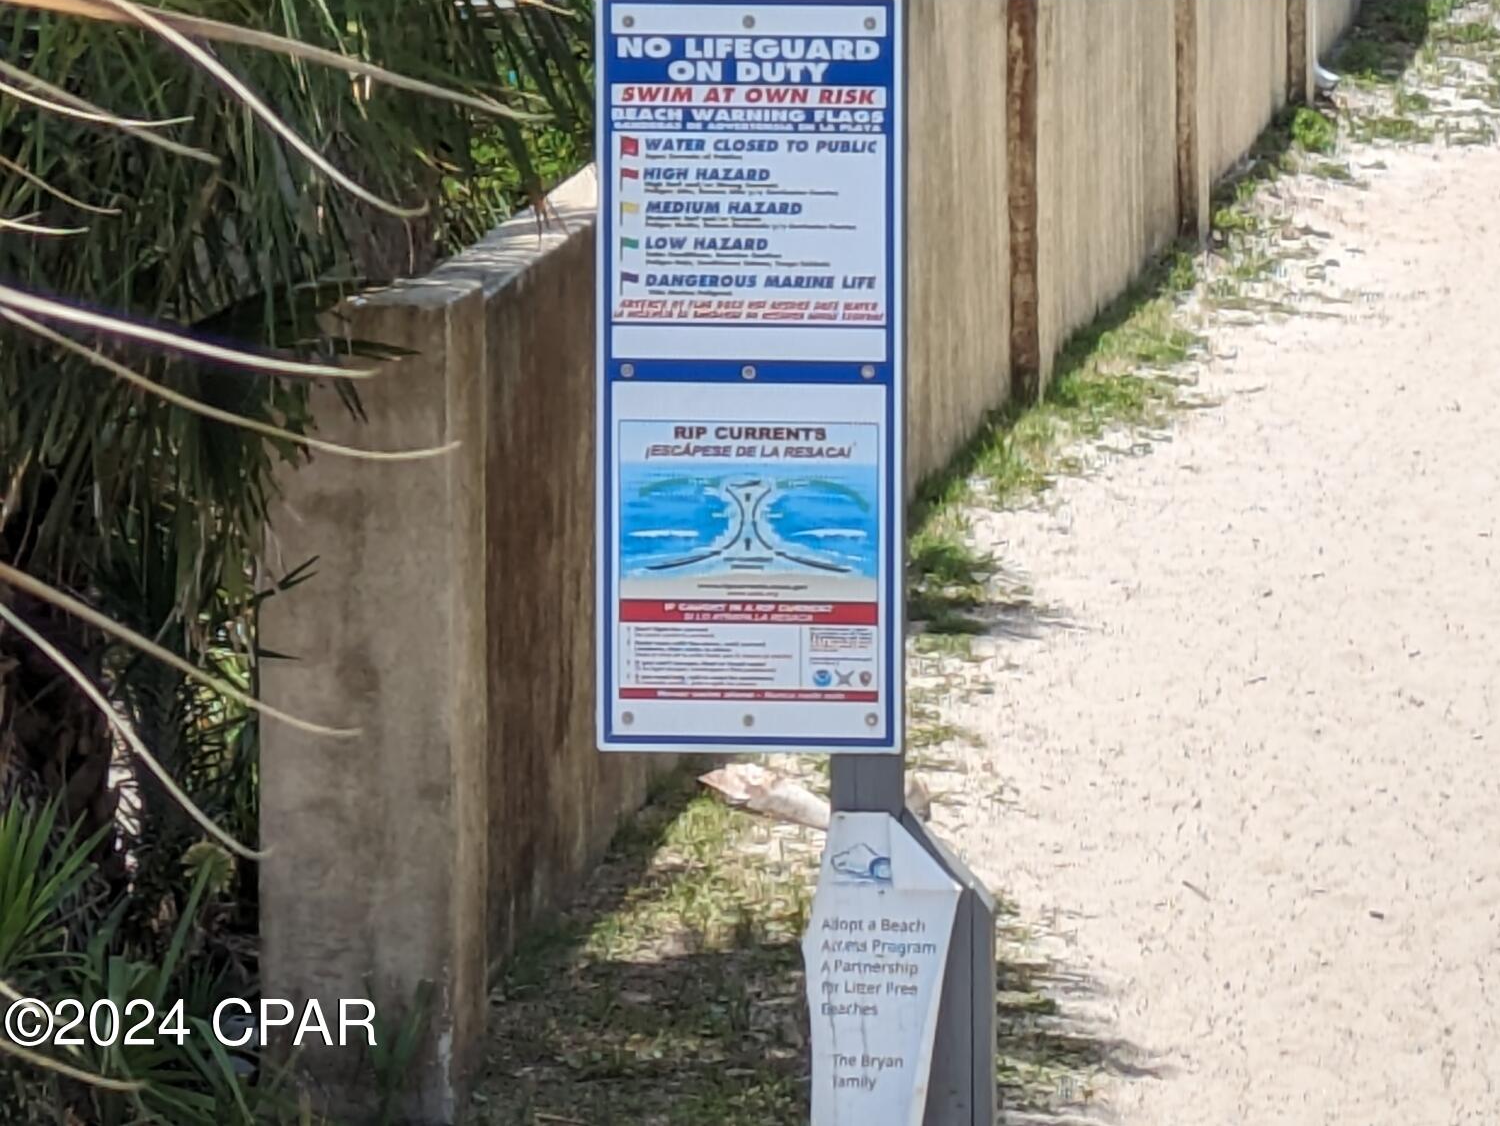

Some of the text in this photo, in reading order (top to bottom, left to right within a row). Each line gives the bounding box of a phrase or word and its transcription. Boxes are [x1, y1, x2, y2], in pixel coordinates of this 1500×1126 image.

[617, 36, 881, 60] NO LIFEGUARD
[668, 61, 829, 83] ON DUTY
[621, 86, 876, 105] SWIM AT OWN RISK
[611, 108, 884, 124] BEACH WARNING FLAGS
[645, 138, 877, 154] WATER CLOSED TO PUBLIC
[644, 168, 770, 182] HIGH HAZARD
[646, 202, 802, 215] MEDIUM HAZARD
[645, 237, 768, 251] LOW HAZARD
[645, 274, 876, 290] DANGEROUS MARINE LIFE
[674, 426, 826, 442] RIP CURRENTS
[736, 444, 756, 458] DE
[760, 445, 780, 458] LA
[822, 918, 925, 933] Adopt a Beach
[821, 939, 936, 956] Access Program
[821, 960, 919, 977] A Partnership
[844, 981, 881, 995] Litter
[832, 1054, 903, 1071] The Bryan
